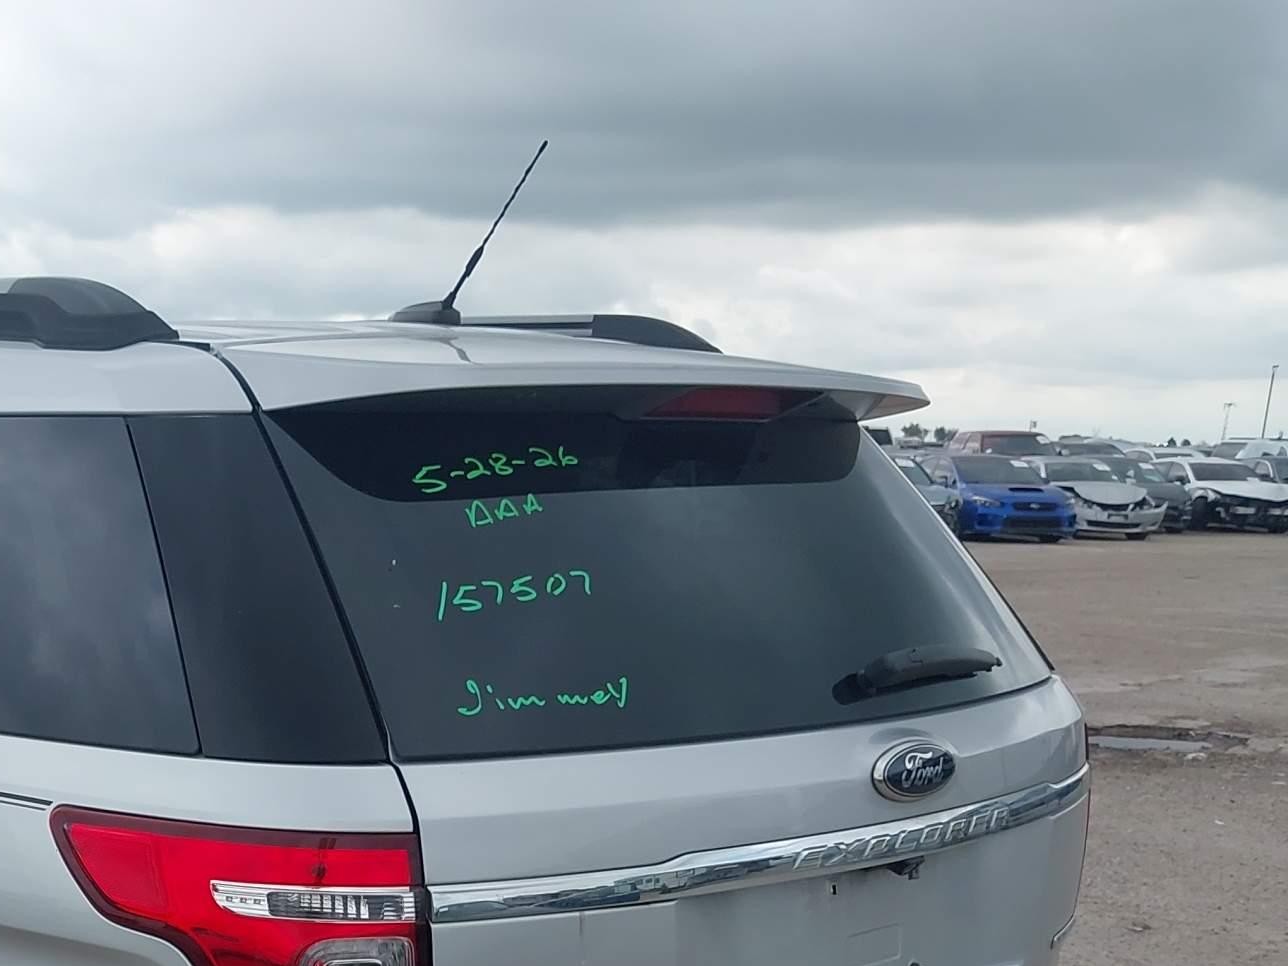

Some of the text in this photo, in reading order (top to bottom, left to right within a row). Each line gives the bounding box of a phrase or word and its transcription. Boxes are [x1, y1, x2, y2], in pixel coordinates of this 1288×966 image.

[412, 446, 579, 494] 5-28-26
[465, 493, 543, 528] AAA
[437, 570, 592, 621] 157507
[901, 752, 944, 788] Ford
[792, 805, 1011, 870] EXPLORER
